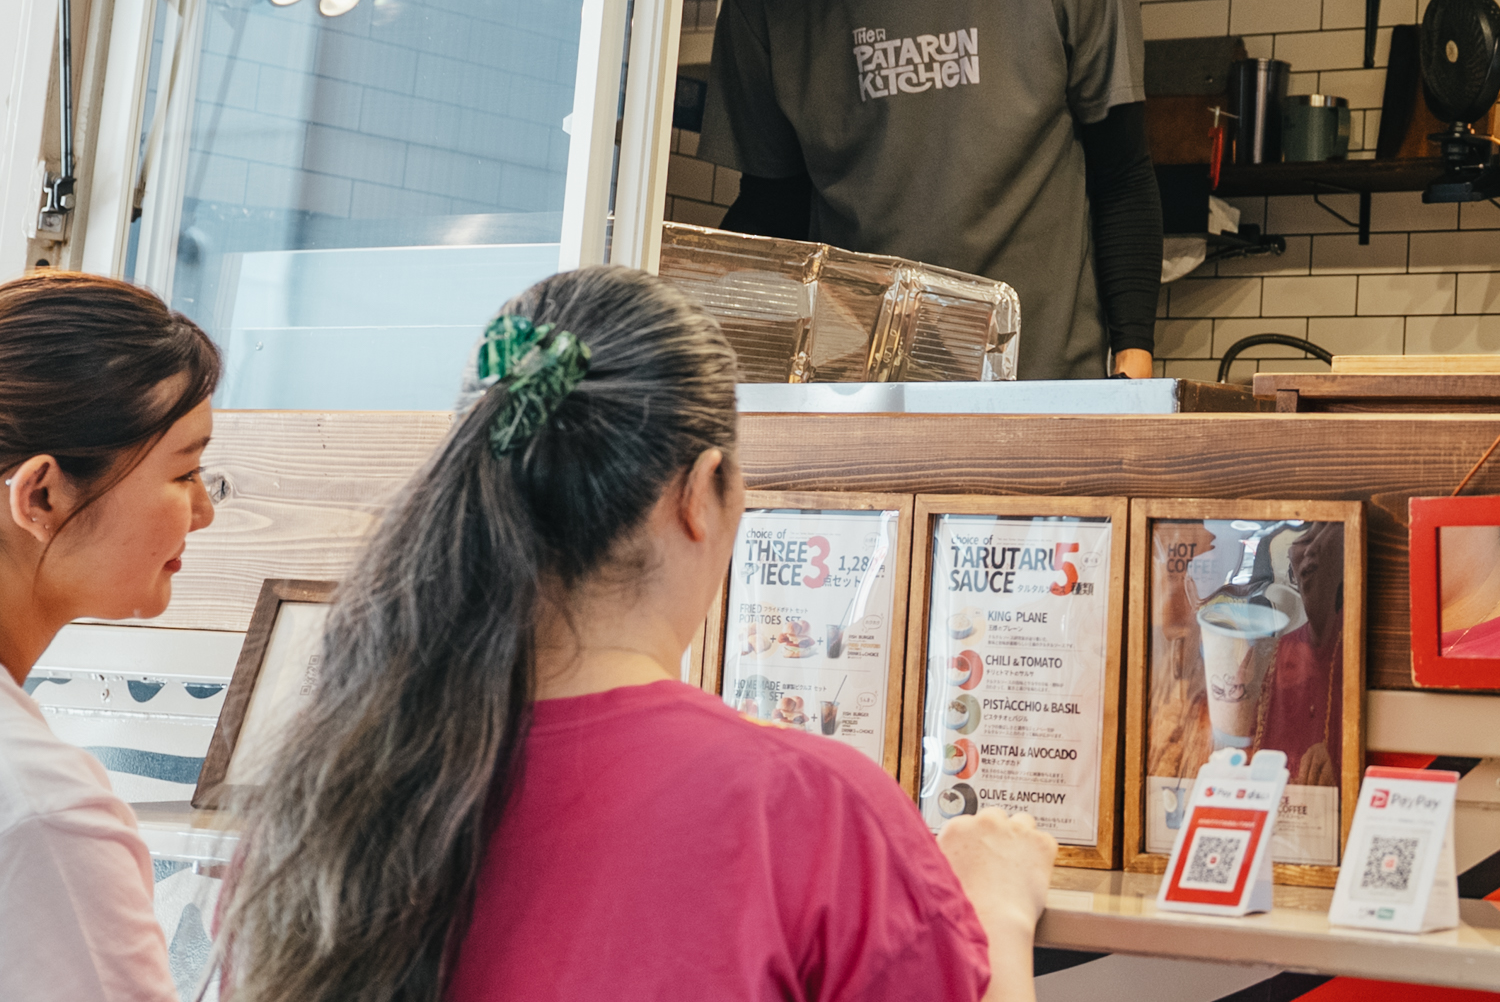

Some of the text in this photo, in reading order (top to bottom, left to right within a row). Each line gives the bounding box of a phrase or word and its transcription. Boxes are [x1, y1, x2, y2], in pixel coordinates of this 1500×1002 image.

[853, 27, 978, 73] PATARUN
[746, 528, 773, 539] choice
[776, 528, 787, 539] of
[983, 535, 994, 546] of
[1167, 542, 1197, 558] HOT
[746, 535, 831, 589] THREE 3
[1050, 542, 1080, 596] 5
[948, 569, 1016, 594] SAUCE
[739, 603, 763, 614] FRIED
[987, 610, 1048, 623] KING PLANE
[985, 654, 1063, 669] CHILI & TOMATO
[1043, 703, 1049, 712] &
[1051, 702, 1081, 715] BASIL
[980, 744, 1078, 760] MENTAI & AVOCADO
[979, 788, 1067, 805] OLIVE & ANCHOVY
[1391, 792, 1440, 812] PayPay
